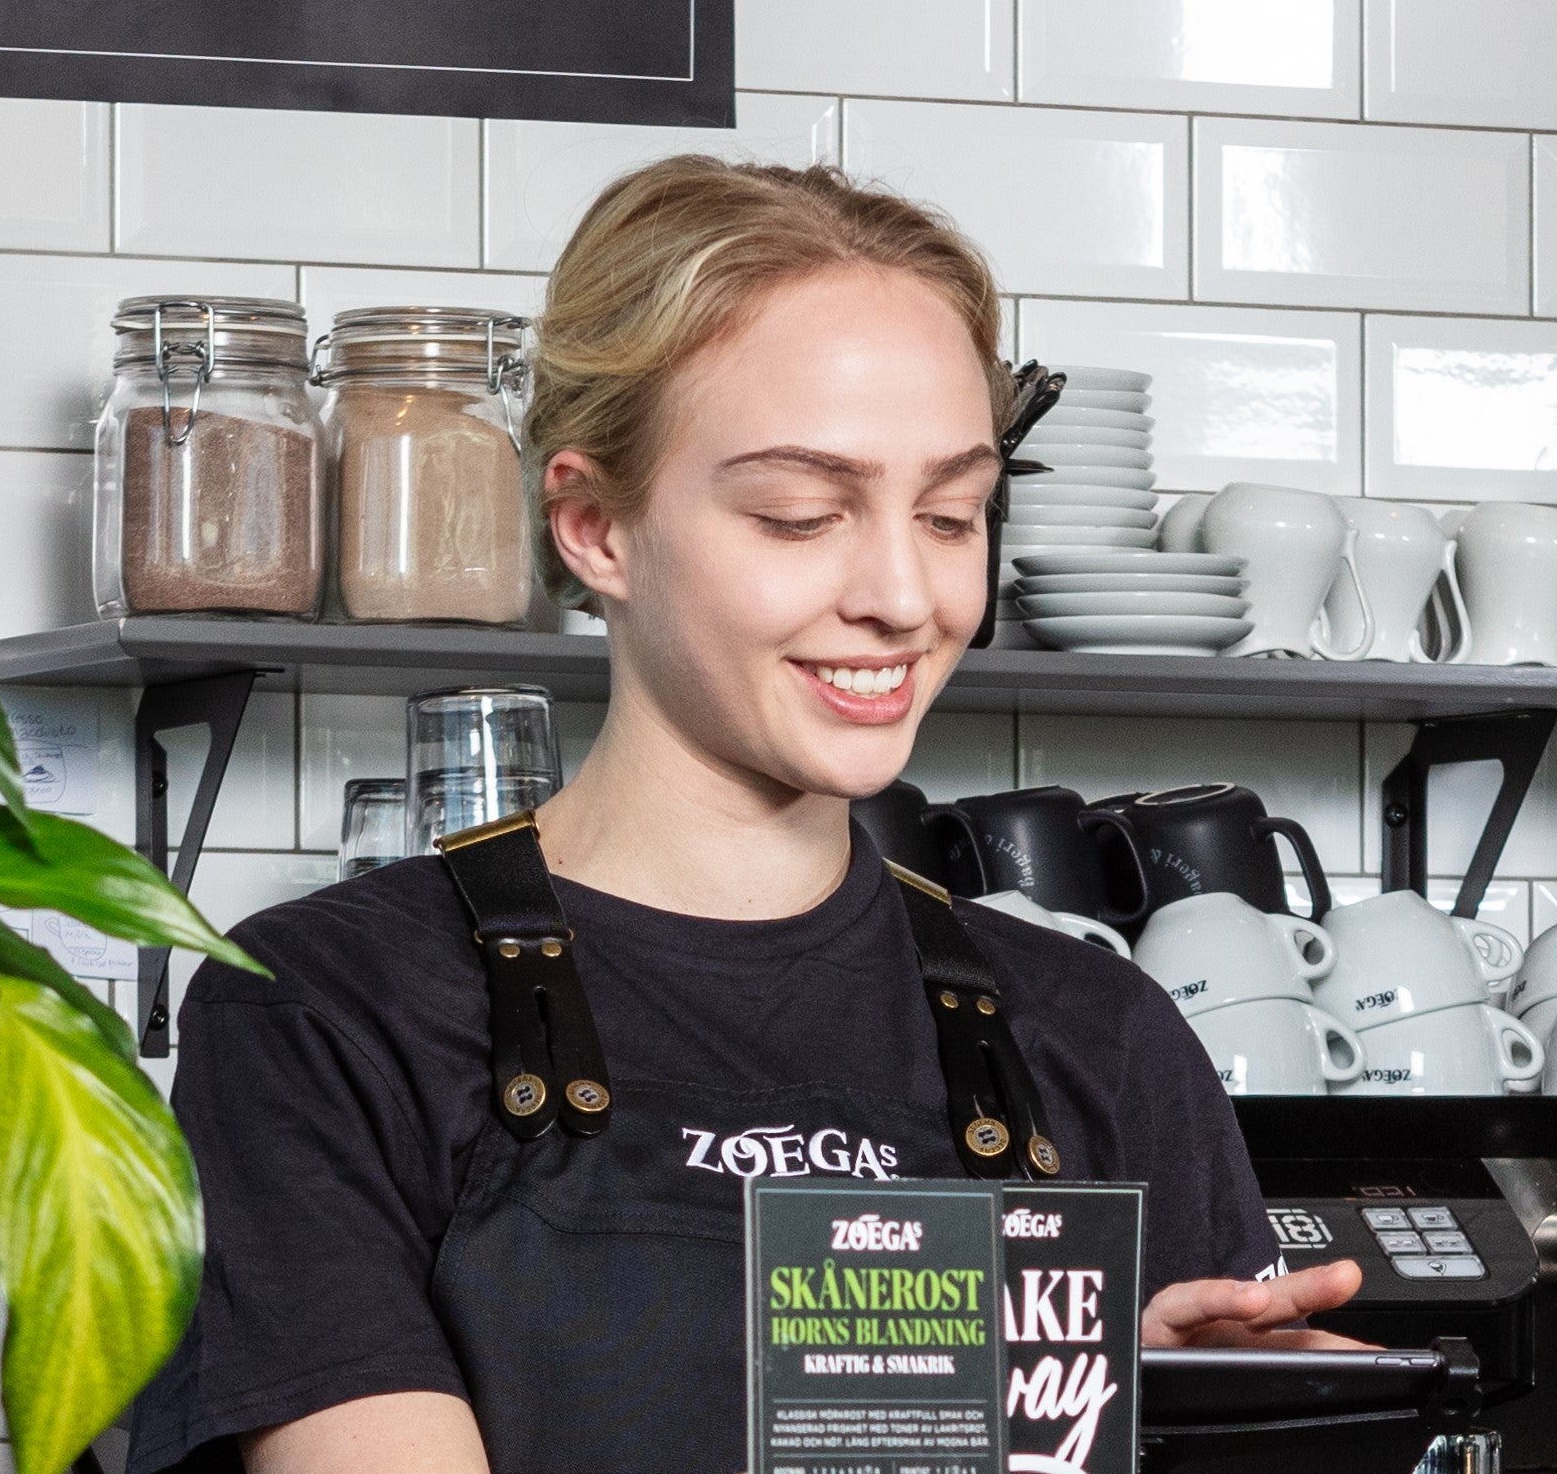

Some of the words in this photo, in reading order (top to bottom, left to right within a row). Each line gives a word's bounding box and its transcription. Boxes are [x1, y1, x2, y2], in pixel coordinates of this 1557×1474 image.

[769, 1257, 985, 1312] SKÅNEROST
[770, 1317, 850, 1347] HORNS
[855, 1317, 987, 1347] BLANDNING
[803, 1353, 871, 1376] KRAFTIG
[872, 1355, 885, 1375] &
[886, 1353, 955, 1376] SMAKRIK
